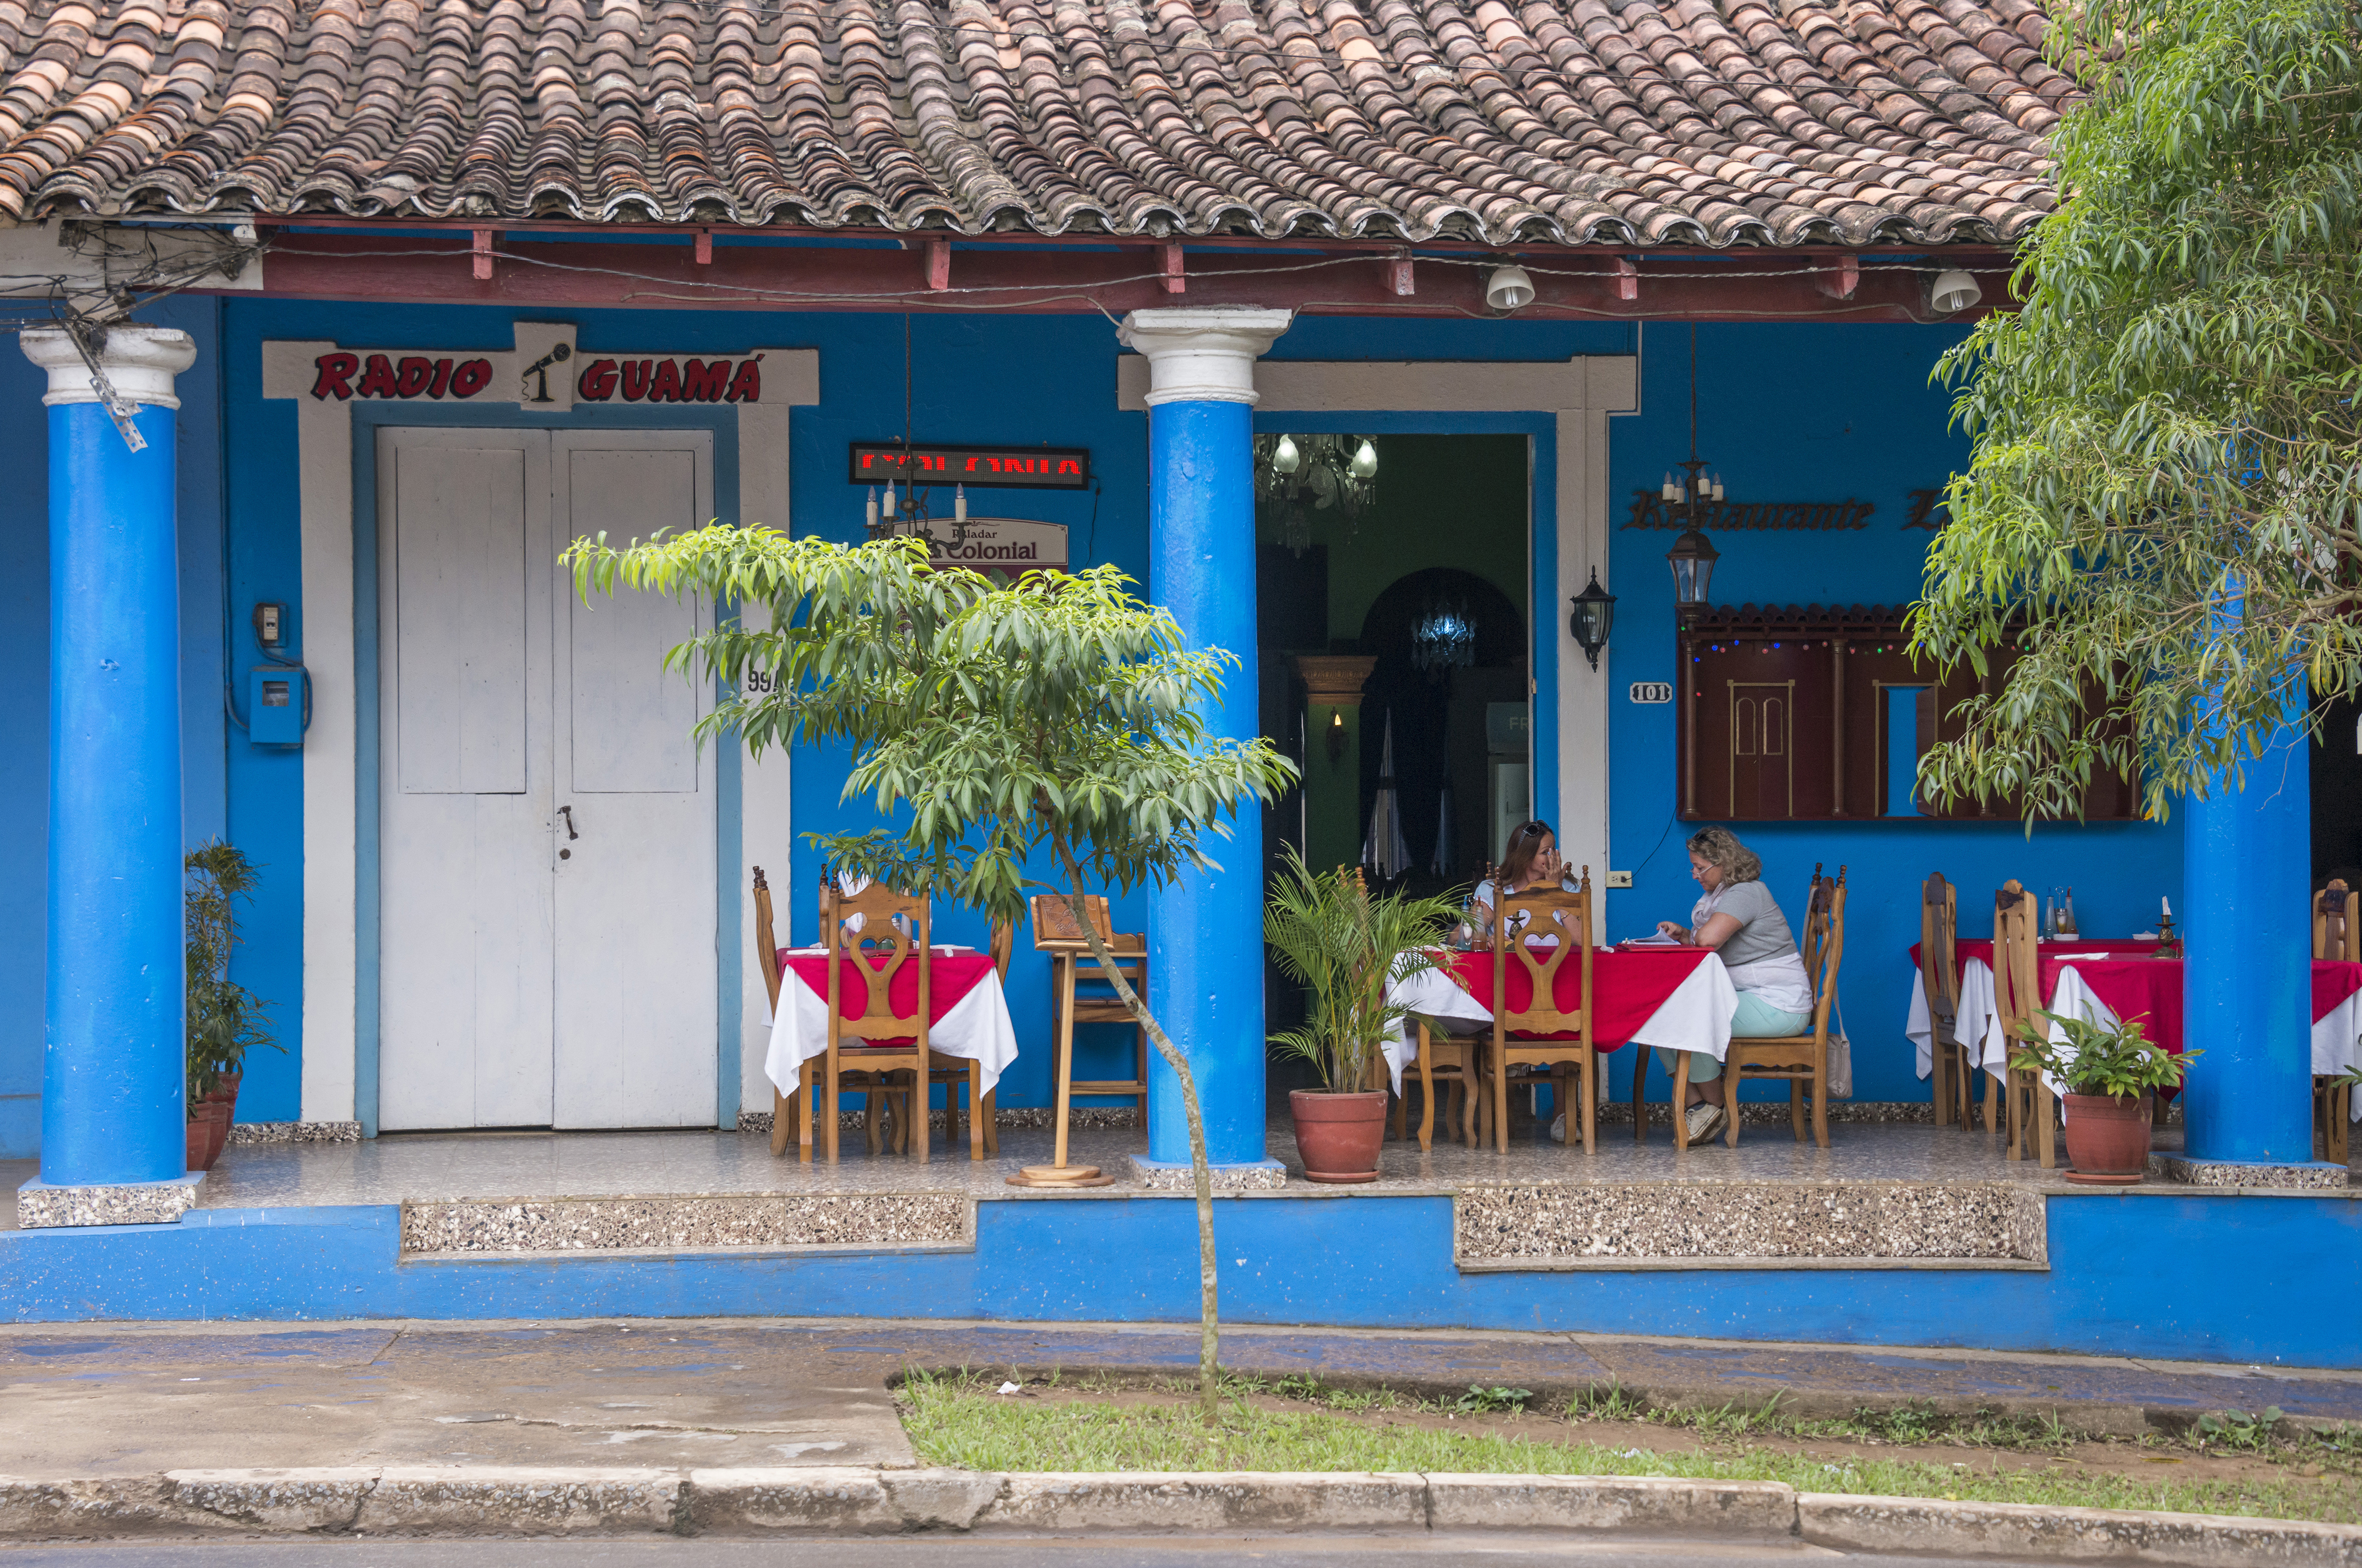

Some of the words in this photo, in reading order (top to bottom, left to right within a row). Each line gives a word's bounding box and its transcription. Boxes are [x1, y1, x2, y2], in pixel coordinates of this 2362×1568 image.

[311, 352, 493, 401] RADIO
[578, 353, 765, 402] GUAMÁ
[1620, 490, 1876, 532] Retaurante
[952, 529, 997, 538] Pladar
[947, 542, 1037, 559] Colonial
[1637, 685, 1665, 700] 101
